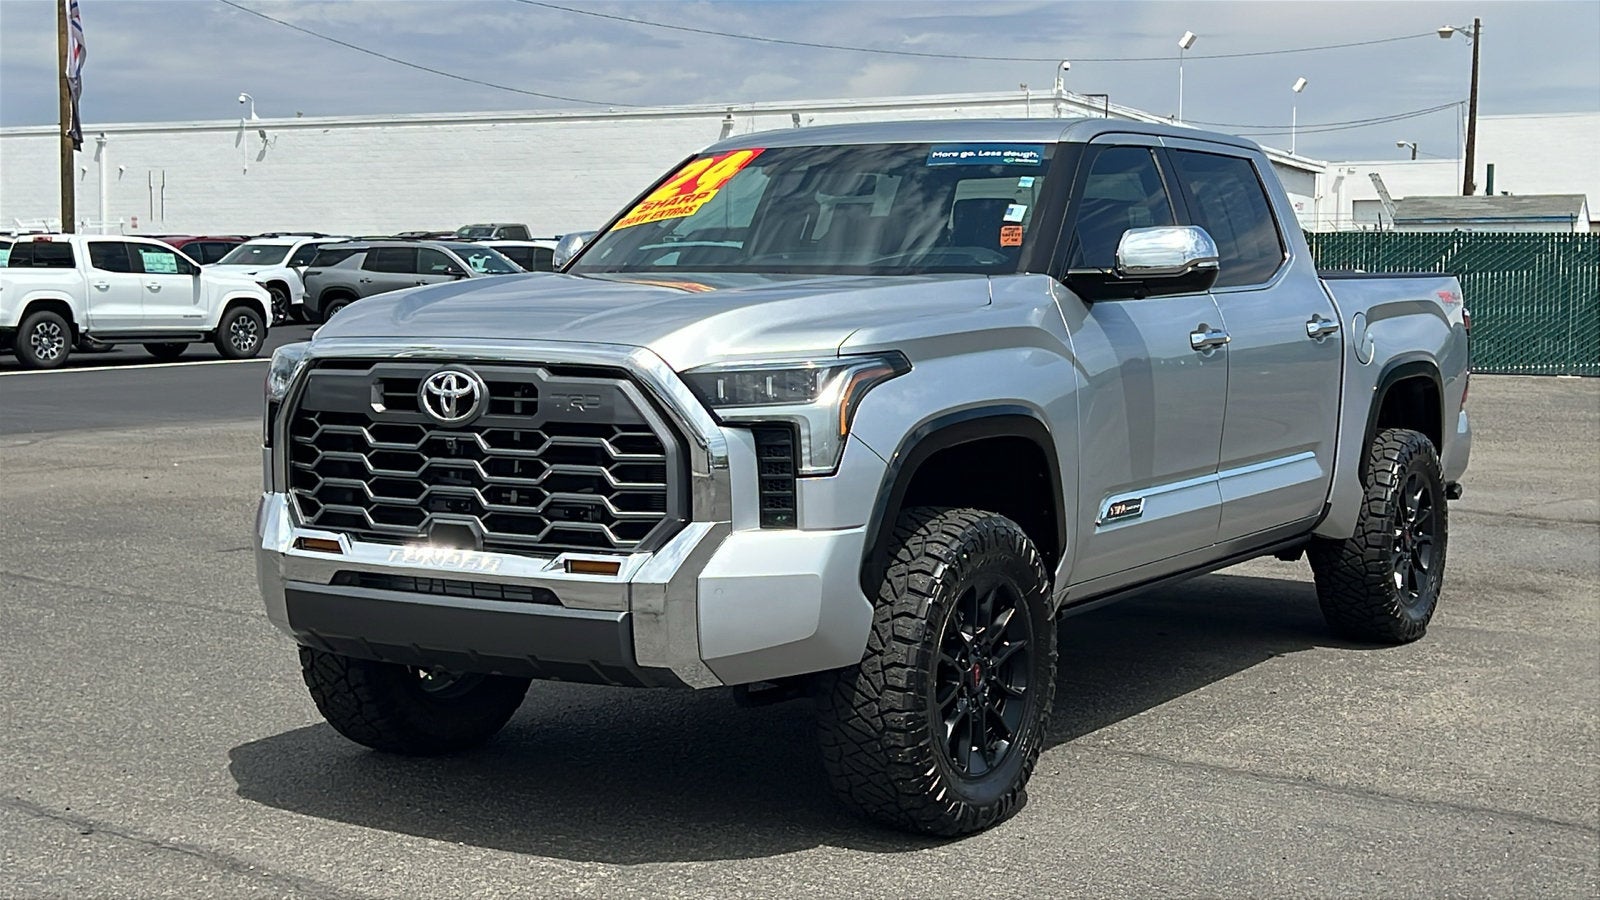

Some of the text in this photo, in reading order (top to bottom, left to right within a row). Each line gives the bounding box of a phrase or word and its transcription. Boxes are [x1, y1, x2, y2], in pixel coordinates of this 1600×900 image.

[1003, 150, 1039, 159] dough.
[644, 150, 753, 201] 24
[638, 191, 711, 213] SHARP
[650, 204, 697, 220] EXTRAS
